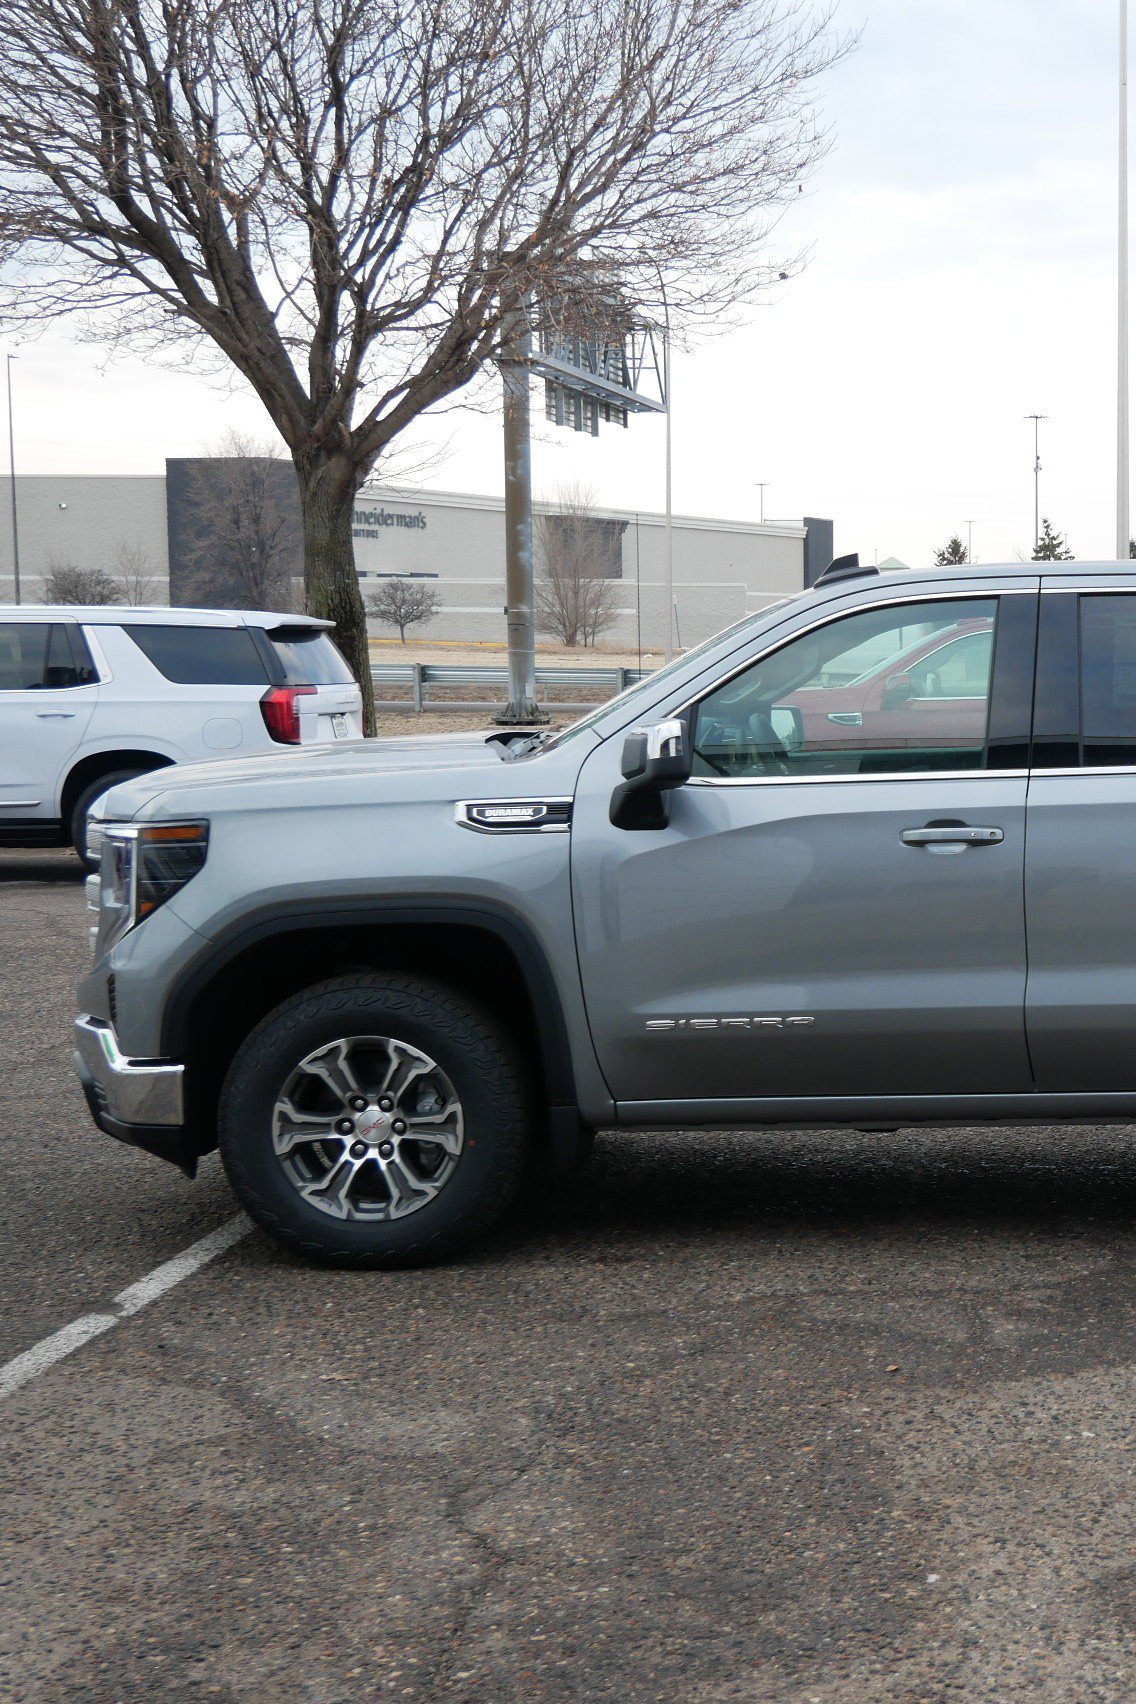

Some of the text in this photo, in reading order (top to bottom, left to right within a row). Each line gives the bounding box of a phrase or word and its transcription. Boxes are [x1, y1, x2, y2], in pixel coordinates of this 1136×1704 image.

[351, 507, 427, 529] hneiderman's
[485, 808, 534, 816] DURAMAX
[646, 1016, 815, 1030] SIERRA
[361, 1117, 384, 1136] GMC
